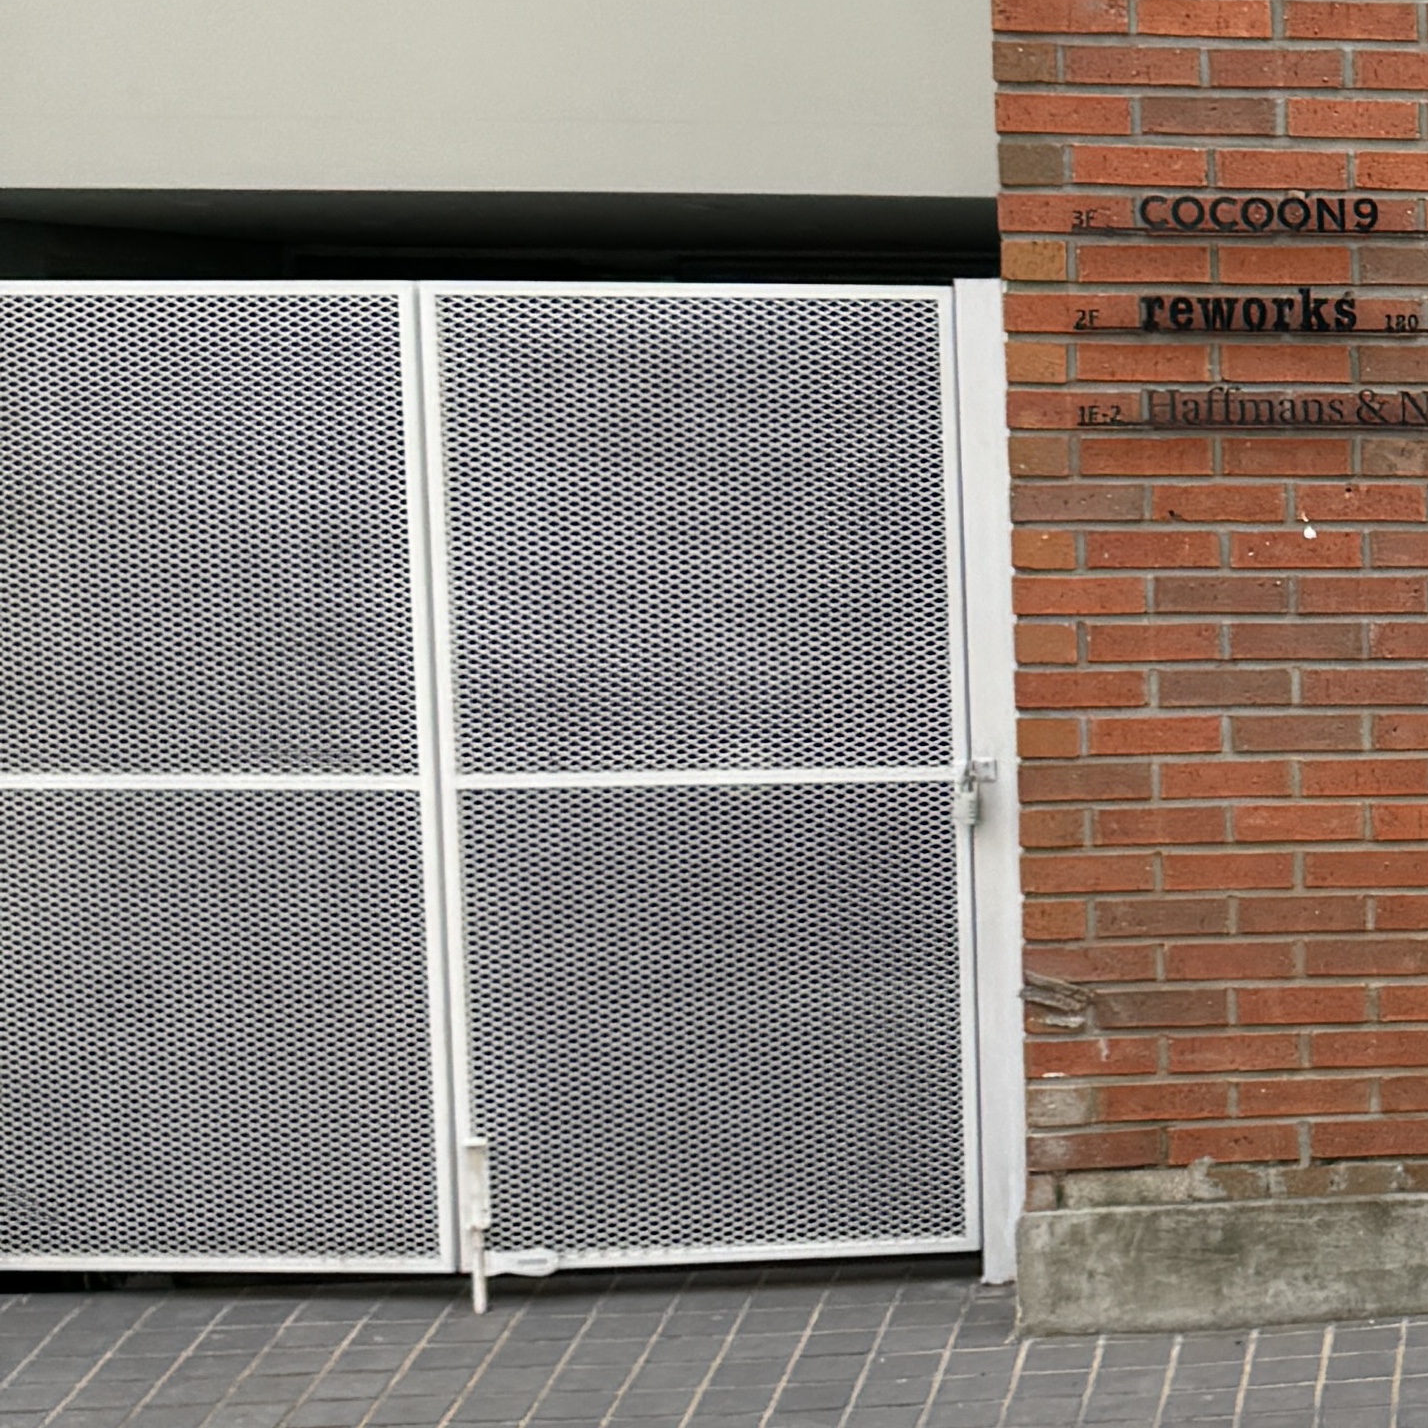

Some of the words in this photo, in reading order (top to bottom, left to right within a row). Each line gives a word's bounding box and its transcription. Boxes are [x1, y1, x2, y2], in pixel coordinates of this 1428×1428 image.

[1073, 209, 1098, 227] 3F
[1139, 195, 1379, 233] COCOON9
[1074, 309, 1099, 330] 2F
[1140, 288, 1358, 332] reworks
[1144, 386, 1345, 427] Haffmans
[1354, 388, 1389, 425] &
